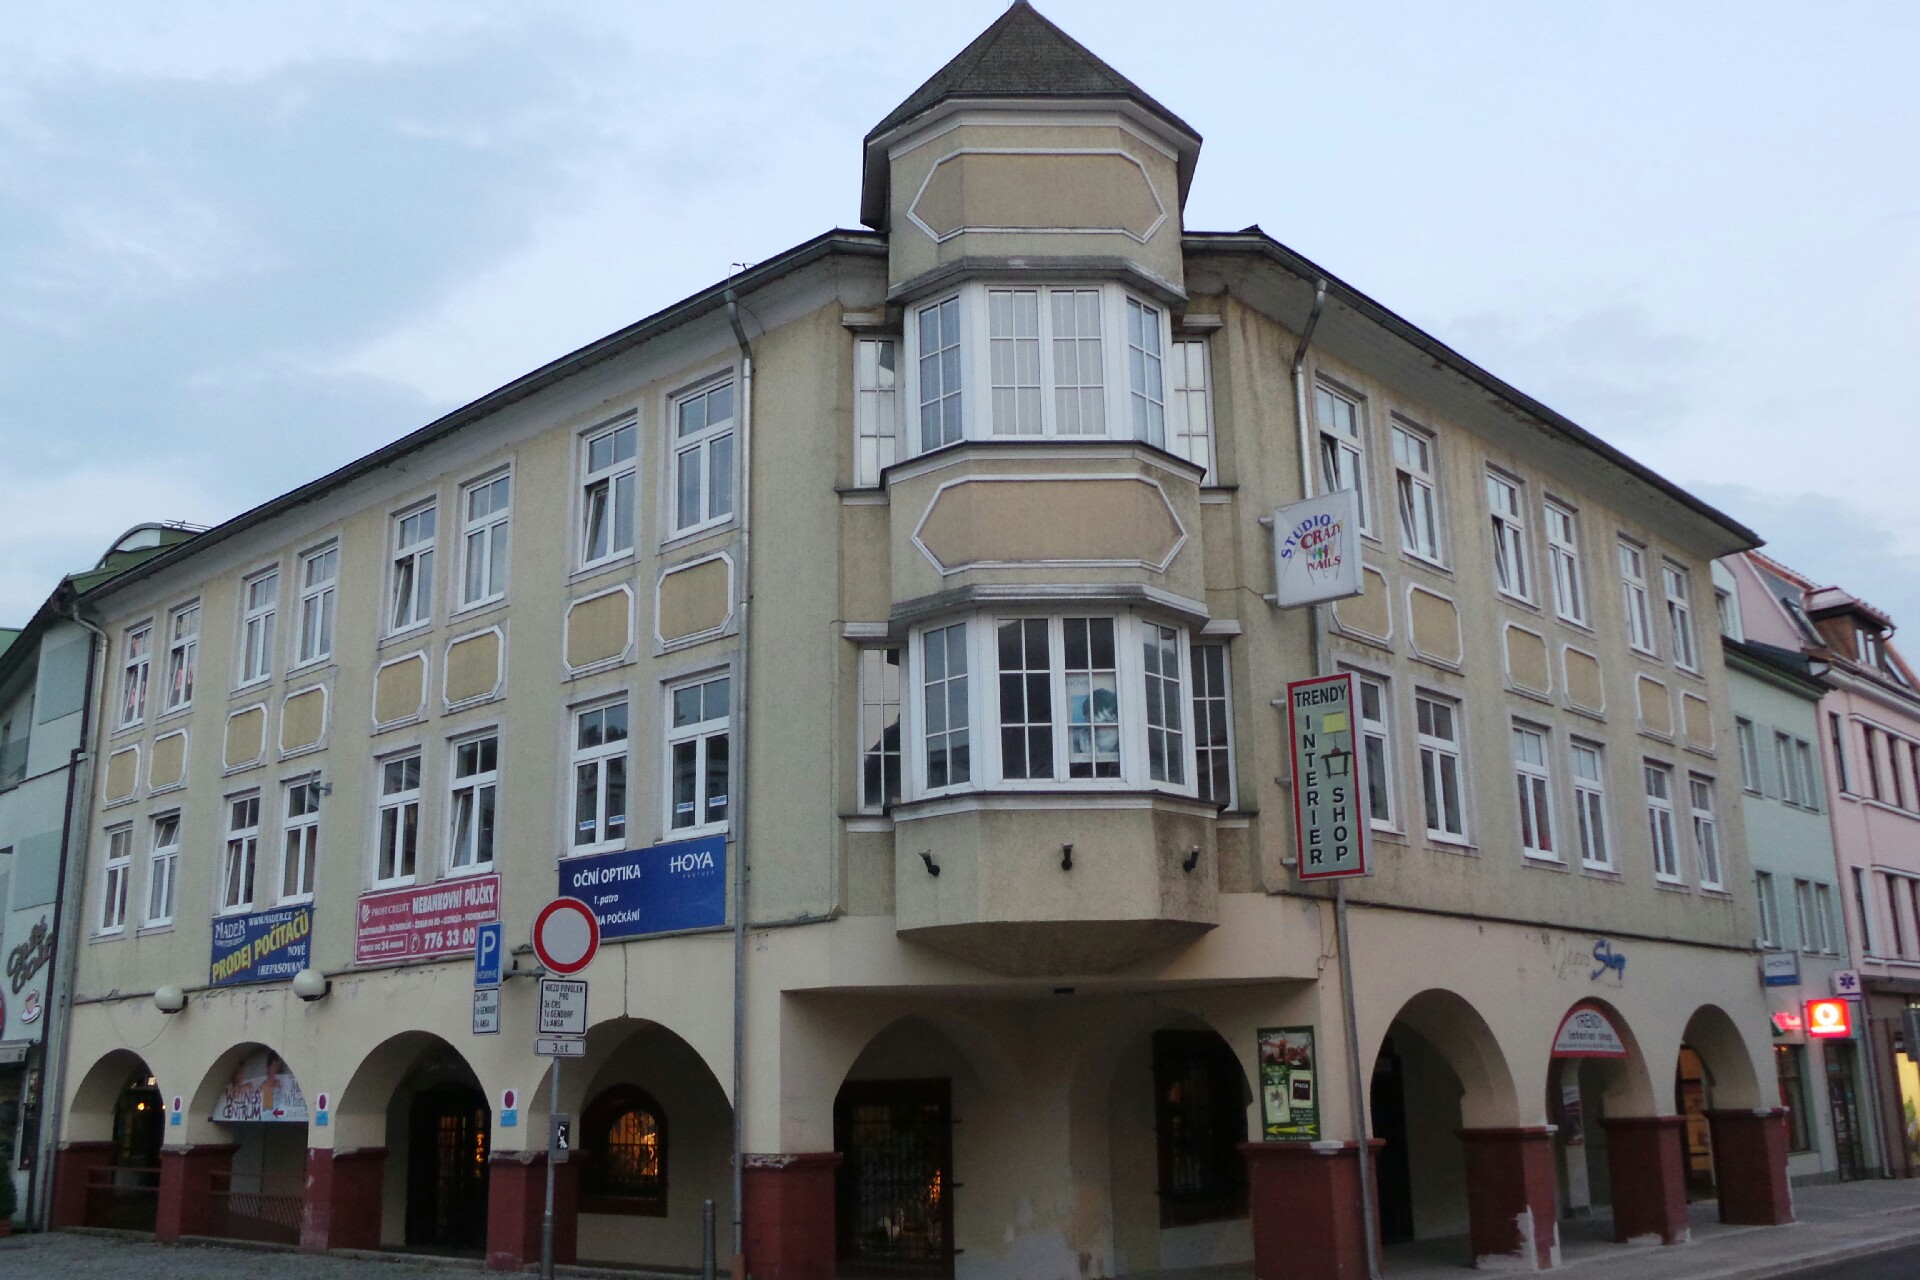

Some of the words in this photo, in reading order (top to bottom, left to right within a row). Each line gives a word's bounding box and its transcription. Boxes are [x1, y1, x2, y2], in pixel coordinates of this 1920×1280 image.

[1281, 514, 1331, 558] STUDIO
[1300, 519, 1345, 550] CRAZY
[1307, 555, 1341, 571] NAILS
[1294, 684, 1347, 708] TRENDY
[1303, 714, 1323, 865] INTERIER
[1332, 787, 1349, 862] SHOP
[670, 851, 714, 873] HOYA
[573, 868, 600, 888] OČNÍ
[601, 864, 641, 884] OPTIKA
[388, 903, 411, 914] CREDIT
[412, 886, 463, 915] NEBANKOVNÍ
[464, 883, 496, 906] PŮJČKY
[594, 895, 600, 905] 1.
[600, 894, 620, 907] patro
[607, 908, 641, 926] POČKÁNÍ
[212, 943, 251, 984] PRODEJ
[255, 907, 309, 960] POČÍTAČŮ
[424, 931, 444, 950] 776
[446, 929, 460, 947] 33
[463, 927, 476, 944] 00
[481, 930, 496, 967] P
[287, 941, 306, 958] NOVÉ
[560, 984, 583, 993] POVOLEN
[544, 1000, 550, 1008] 3x
[551, 1000, 561, 1008] CRS
[544, 1010, 549, 1018] 1x
[550, 1010, 574, 1019] GENDORF
[544, 1019, 549, 1027] 1x
[225, 1088, 261, 1104] WELLNESS
[223, 1104, 262, 1121] CENTRUM
